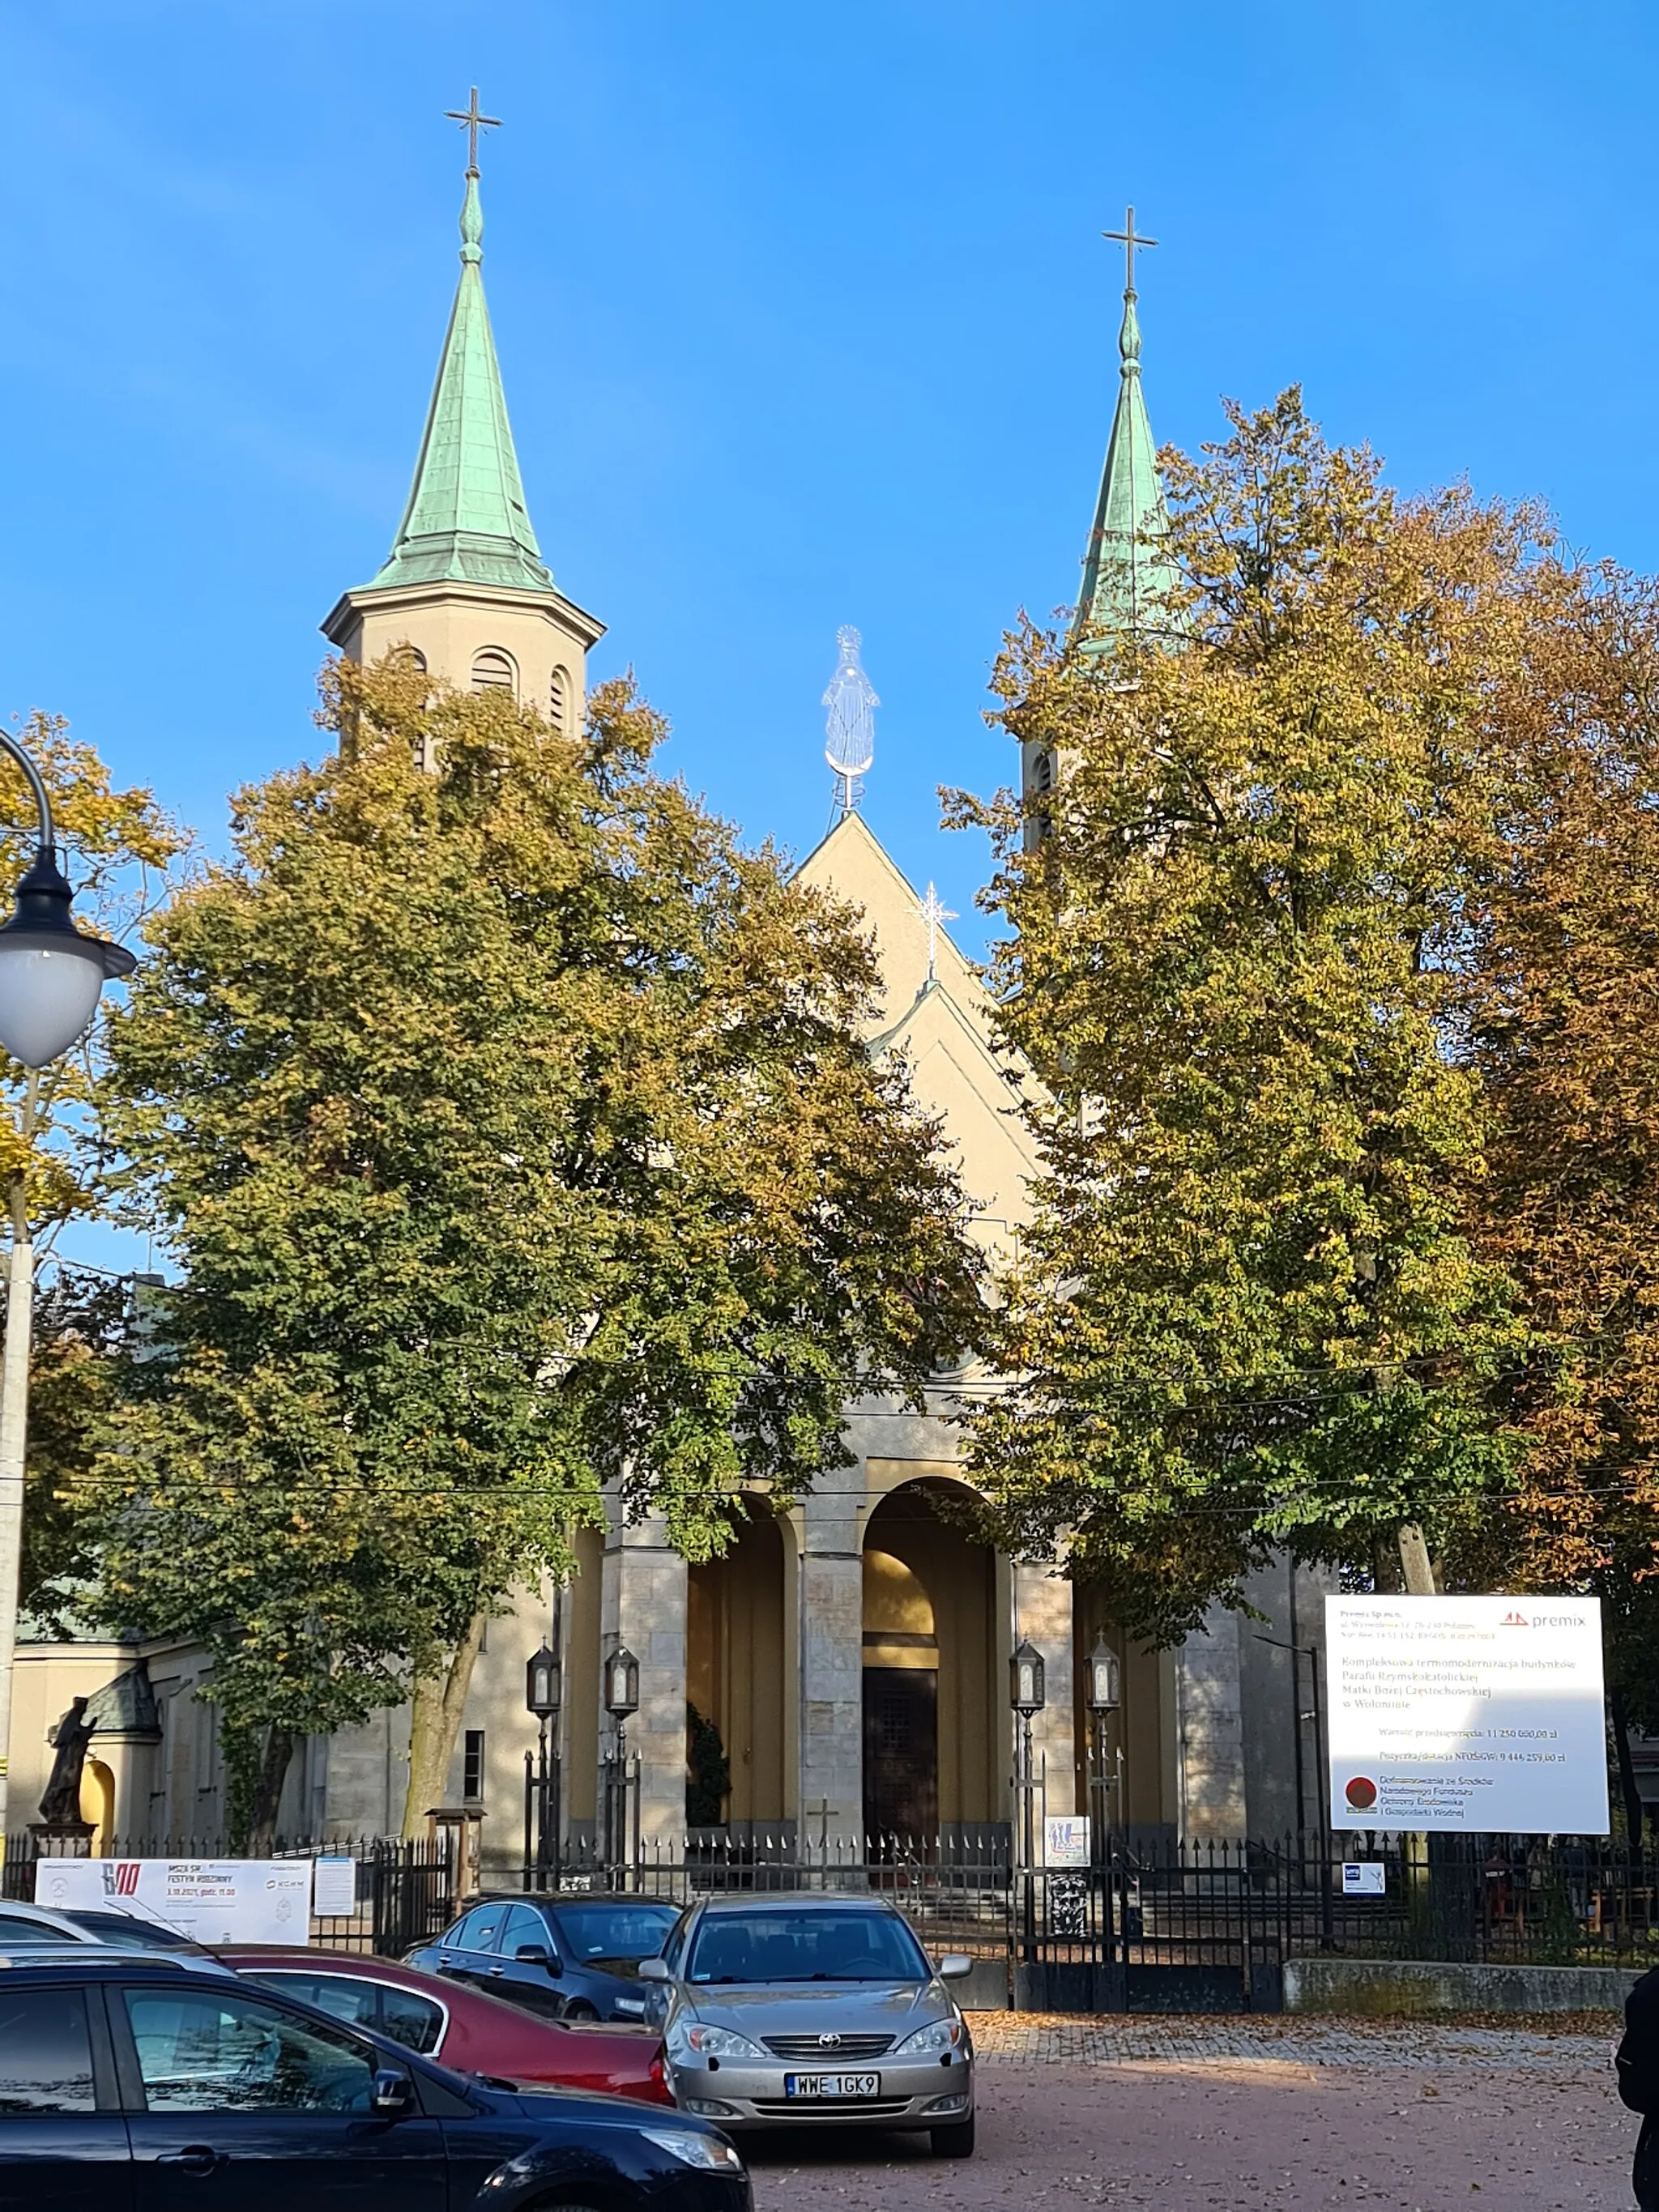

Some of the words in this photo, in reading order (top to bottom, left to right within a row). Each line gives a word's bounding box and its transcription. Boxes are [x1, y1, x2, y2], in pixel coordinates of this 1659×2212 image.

[1532, 1613, 1587, 1629] premix
[1341, 1656, 1414, 1669] Kompleksowa
[1417, 1658, 1519, 1670] termomodernizacja
[1521, 1659, 1576, 1670] budynków
[1341, 1670, 1375, 1681] Parafii
[1378, 1671, 1478, 1684] Rzymskokatolickiej
[1341, 1684, 1371, 1694] Matki
[1375, 1685, 1403, 1698] Bożej
[1405, 1685, 1491, 1699] Częstochowskiej
[1354, 1698, 1411, 1709] Wołominie
[798, 2076, 829, 2094] WWE
[837, 2076, 875, 2093] 1GK9
